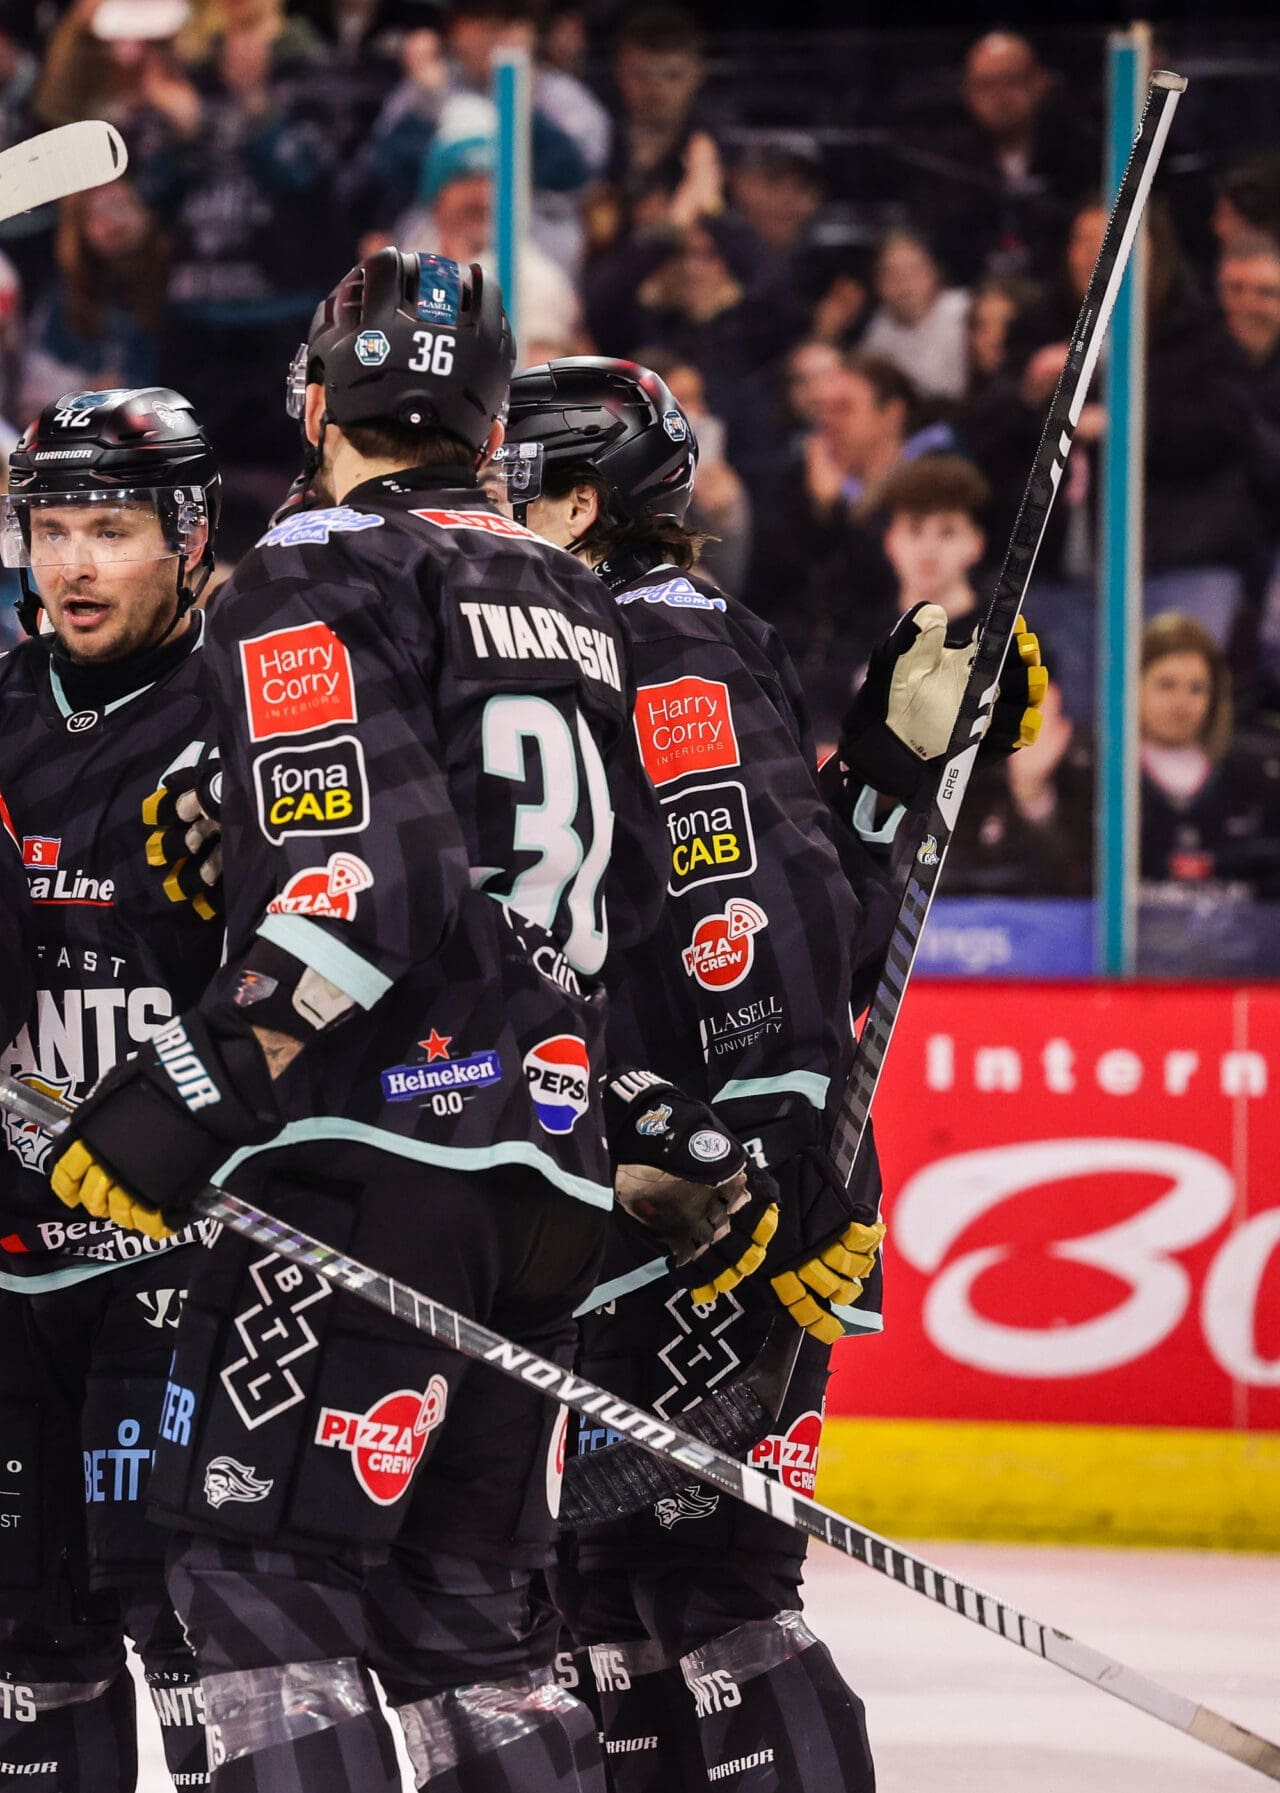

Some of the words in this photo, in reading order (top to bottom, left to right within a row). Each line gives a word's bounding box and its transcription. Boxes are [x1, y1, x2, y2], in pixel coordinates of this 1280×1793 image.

[408, 331, 456, 376] 36
[53, 407, 96, 428] 42
[34, 450, 93, 461] WARRIOR
[260, 643, 333, 678] Harry
[263, 671, 340, 705] Corry
[265, 694, 341, 719] INTERIORS
[648, 695, 719, 726] Harry
[652, 719, 724, 752] Corry
[656, 741, 725, 766] INTERIORS
[270, 764, 349, 798] fona
[942, 768, 960, 800] QR6
[269, 788, 354, 825] CAB
[666, 806, 733, 845] fona
[31, 842, 43, 863] S
[673, 833, 742, 877] CAB
[53, 869, 115, 901] Line
[699, 950, 743, 973] CREW
[709, 996, 783, 1035] LASELL
[152, 1014, 222, 1113] RIOR
[388, 1061, 495, 1095] Heineken
[526, 1065, 588, 1103] PEPS
[431, 1091, 463, 1116] 0.0
[483, 1341, 677, 1450] NOVIUM
[320, 1413, 414, 1454] PIZZA
[83, 1449, 156, 1504] BETT
[368, 1453, 415, 1475] CREW
